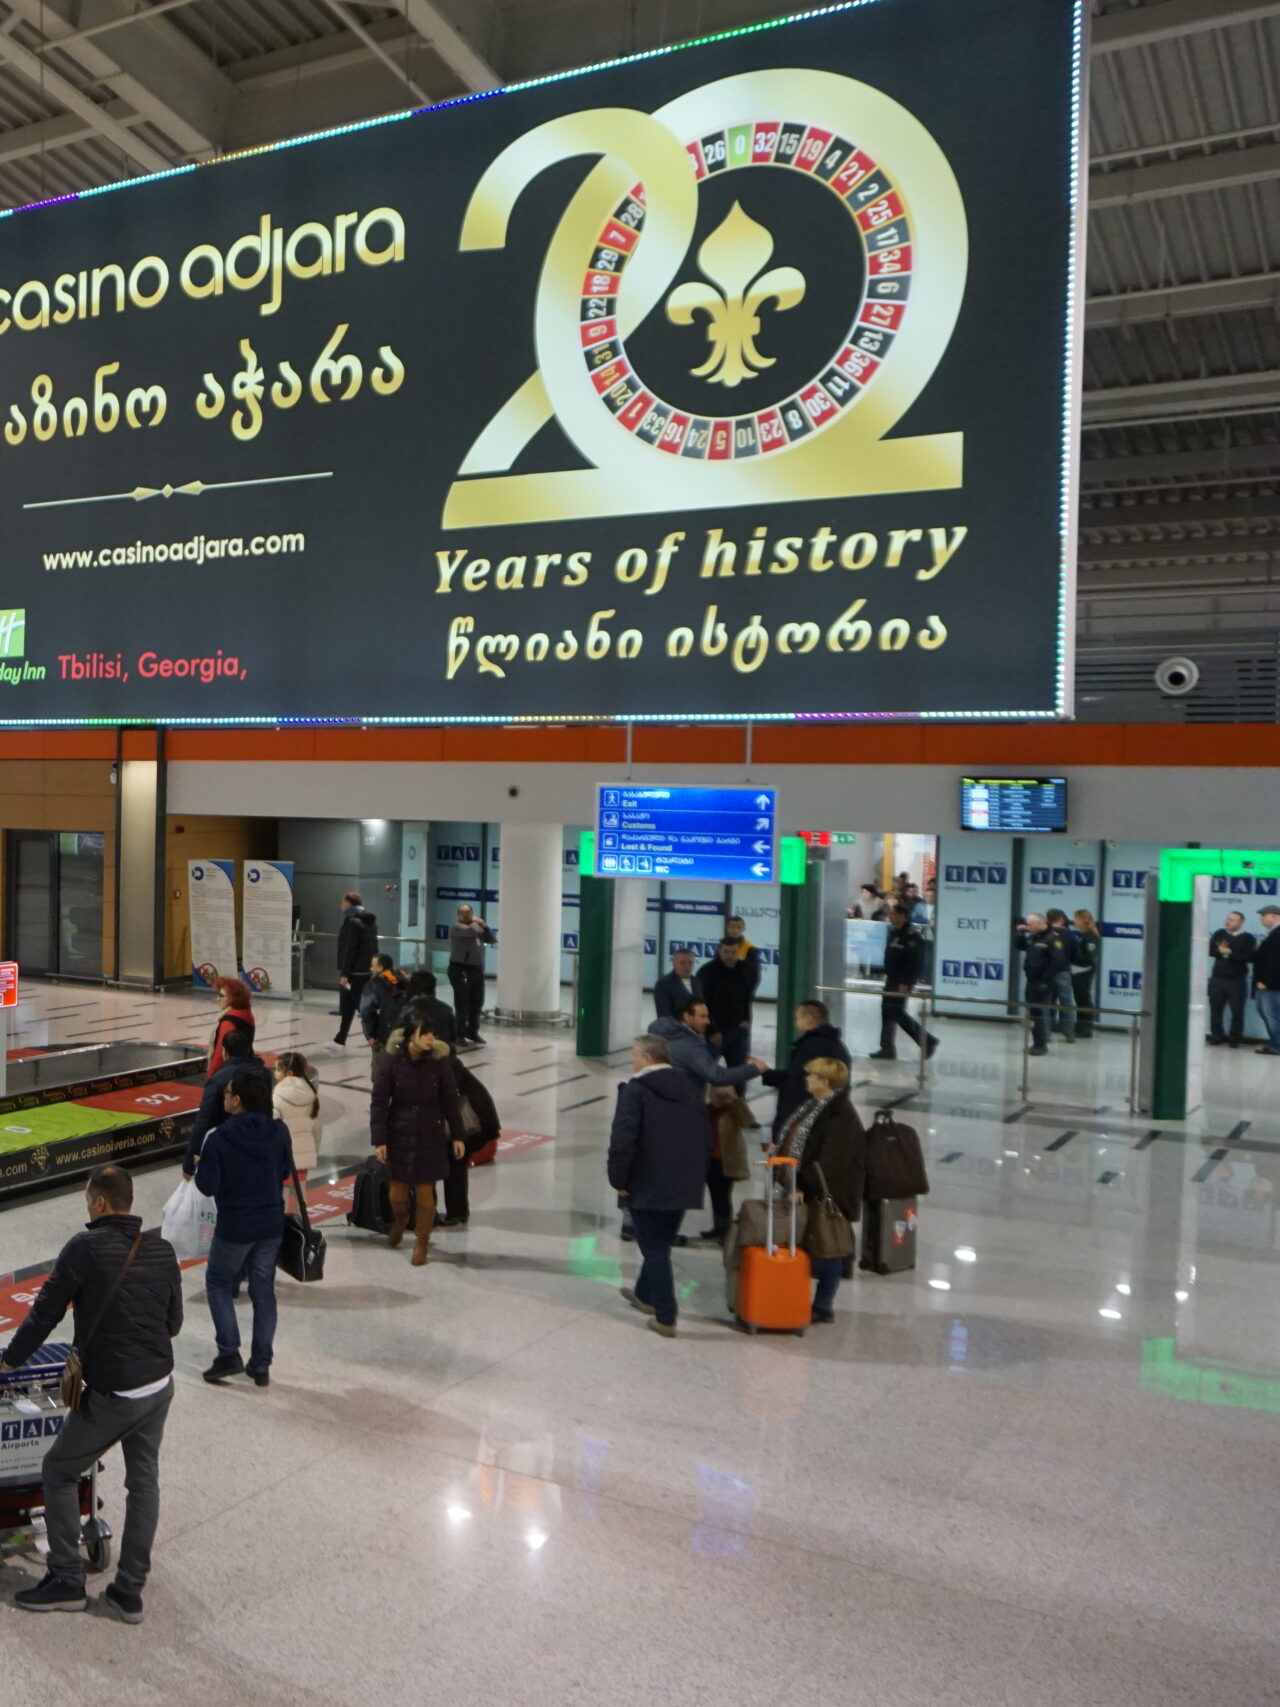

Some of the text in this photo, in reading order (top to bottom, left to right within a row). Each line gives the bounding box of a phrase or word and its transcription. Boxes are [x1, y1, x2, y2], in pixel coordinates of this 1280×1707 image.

[704, 139, 725, 165] 26
[734, 134, 745, 156] 0
[754, 131, 777, 153] 32
[779, 133, 800, 155] 15
[801, 138, 823, 161] 19
[825, 150, 842, 170] 4
[839, 162, 865, 187] 21
[857, 183, 879, 201] 2
[621, 203, 644, 228] 28
[866, 199, 893, 226] 25
[609, 230, 627, 244] 7
[876, 226, 900, 247] 17
[180, 206, 406, 316] adjara
[596, 249, 619, 272] 29
[879, 251, 901, 274] 34
[591, 274, 611, 293] 18
[876, 281, 900, 294] 6
[587, 298, 607, 318] 22
[870, 304, 895, 326] 27
[588, 325, 607, 338] 9
[857, 330, 883, 351] 13
[592, 343, 613, 365] 31
[843, 352, 871, 377] 36
[195, 323, 406, 441] აჭარა
[599, 365, 620, 386] 14
[825, 375, 851, 397] 11
[610, 382, 633, 406] 20
[806, 392, 831, 416] 30
[627, 401, 643, 418] 1
[786, 409, 803, 429] 8
[643, 411, 665, 436] 33
[664, 422, 684, 444] 16
[760, 418, 782, 442] 23
[687, 428, 709, 449] 24
[715, 430, 727, 449] 5
[737, 428, 756, 447] 10
[42, 532, 305, 571] www.casinoadjara.com
[434, 525, 968, 596] Years of history
[445, 598, 949, 680] წლიანი ისტორია
[22, 660, 46, 681] Inn
[57, 650, 248, 684] Tbilisi, Georgia,
[622, 799, 638, 808] Exit
[621, 821, 656, 830] Customs
[621, 843, 638, 851] Lost
[647, 844, 673, 852] Found
[655, 866, 670, 874] WC
[947, 867, 1006, 883] TAV
[1032, 868, 1094, 885] TAV
[957, 917, 990, 931] EXIT
[943, 961, 1003, 980] TAV
[135, 1093, 181, 1105] 32
[3, 1125, 33, 1134] 0
[55, 1132, 155, 1165] www.casinoiveria.com
[3, 1417, 62, 1440] TAV
[1, 1440, 40, 1450] Airports
